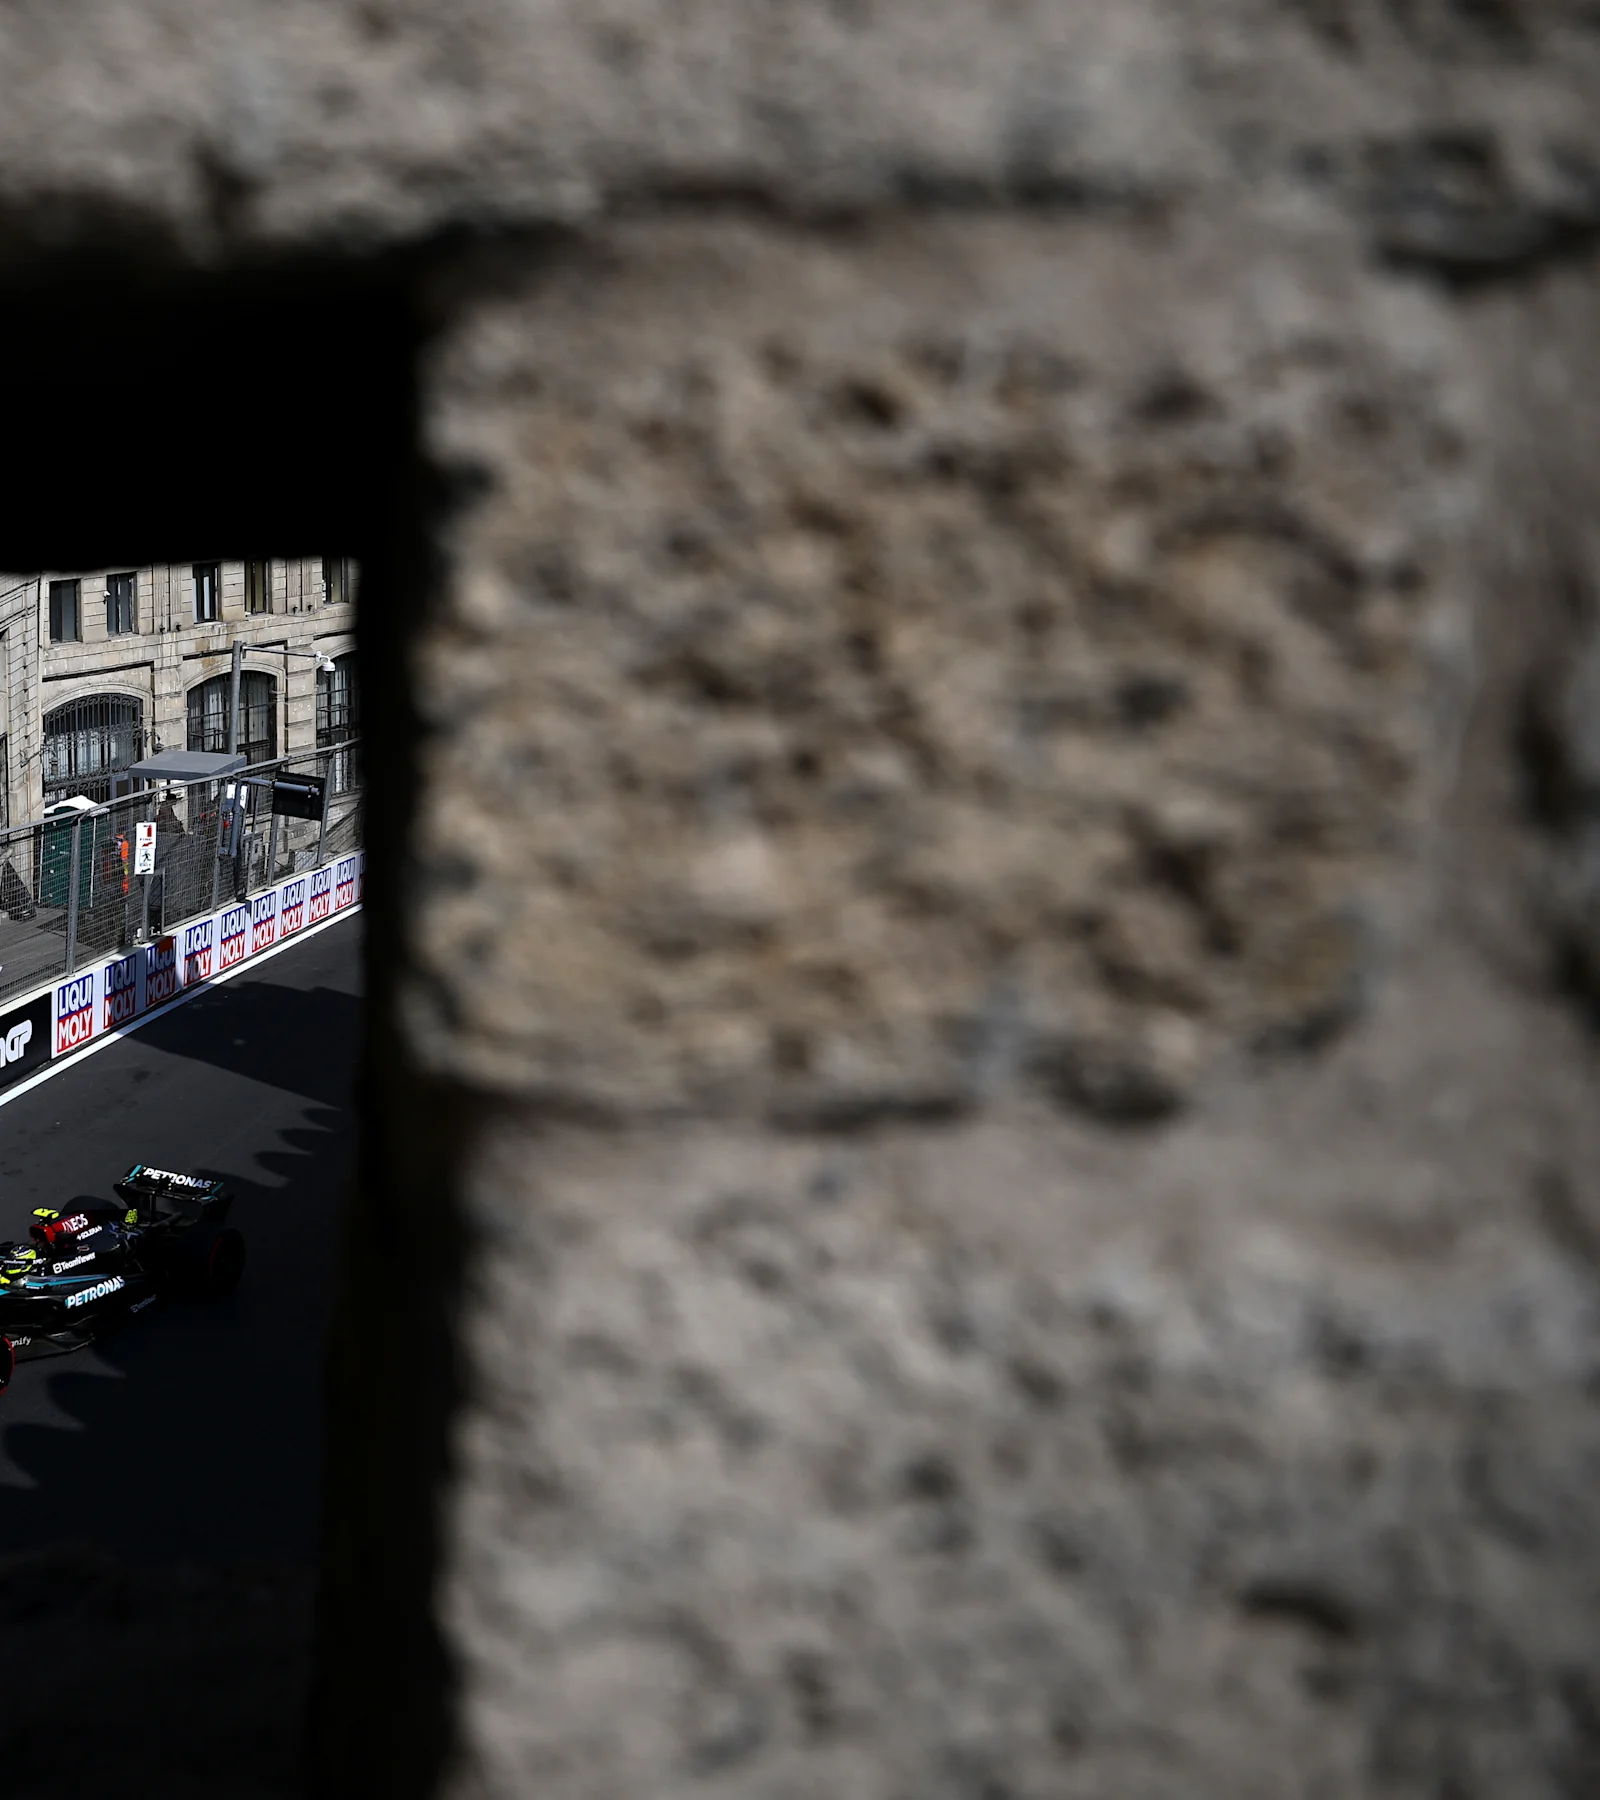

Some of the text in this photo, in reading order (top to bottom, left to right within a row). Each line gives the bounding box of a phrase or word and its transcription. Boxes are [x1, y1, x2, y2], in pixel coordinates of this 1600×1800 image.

[311, 869, 331, 897] LIQUI
[337, 858, 355, 886] LIQUI
[253, 893, 276, 925] LIQUI
[282, 881, 305, 910] LIQUI
[309, 892, 330, 922] MOLY
[336, 881, 354, 909] MOLY
[221, 907, 246, 939] LIQUI
[252, 918, 275, 951] MOLY
[280, 905, 304, 936] MOLY
[186, 922, 213, 955] LIQUI
[220, 934, 245, 968] MOLY
[146, 936, 176, 974] LIQUI
[185, 949, 212, 985] MOLY
[105, 956, 136, 995] LIQUI
[146, 968, 176, 1006] MOLY
[58, 976, 93, 1018] LIQUI
[104, 986, 136, 1027] MOLY
[58, 1007, 93, 1050] MOLY
[143, 1167, 212, 1189] PETRONAS
[61, 1213, 89, 1233] INEOS
[61, 1252, 96, 1270] TeamViewer
[66, 1276, 125, 1309] PETRONAS
